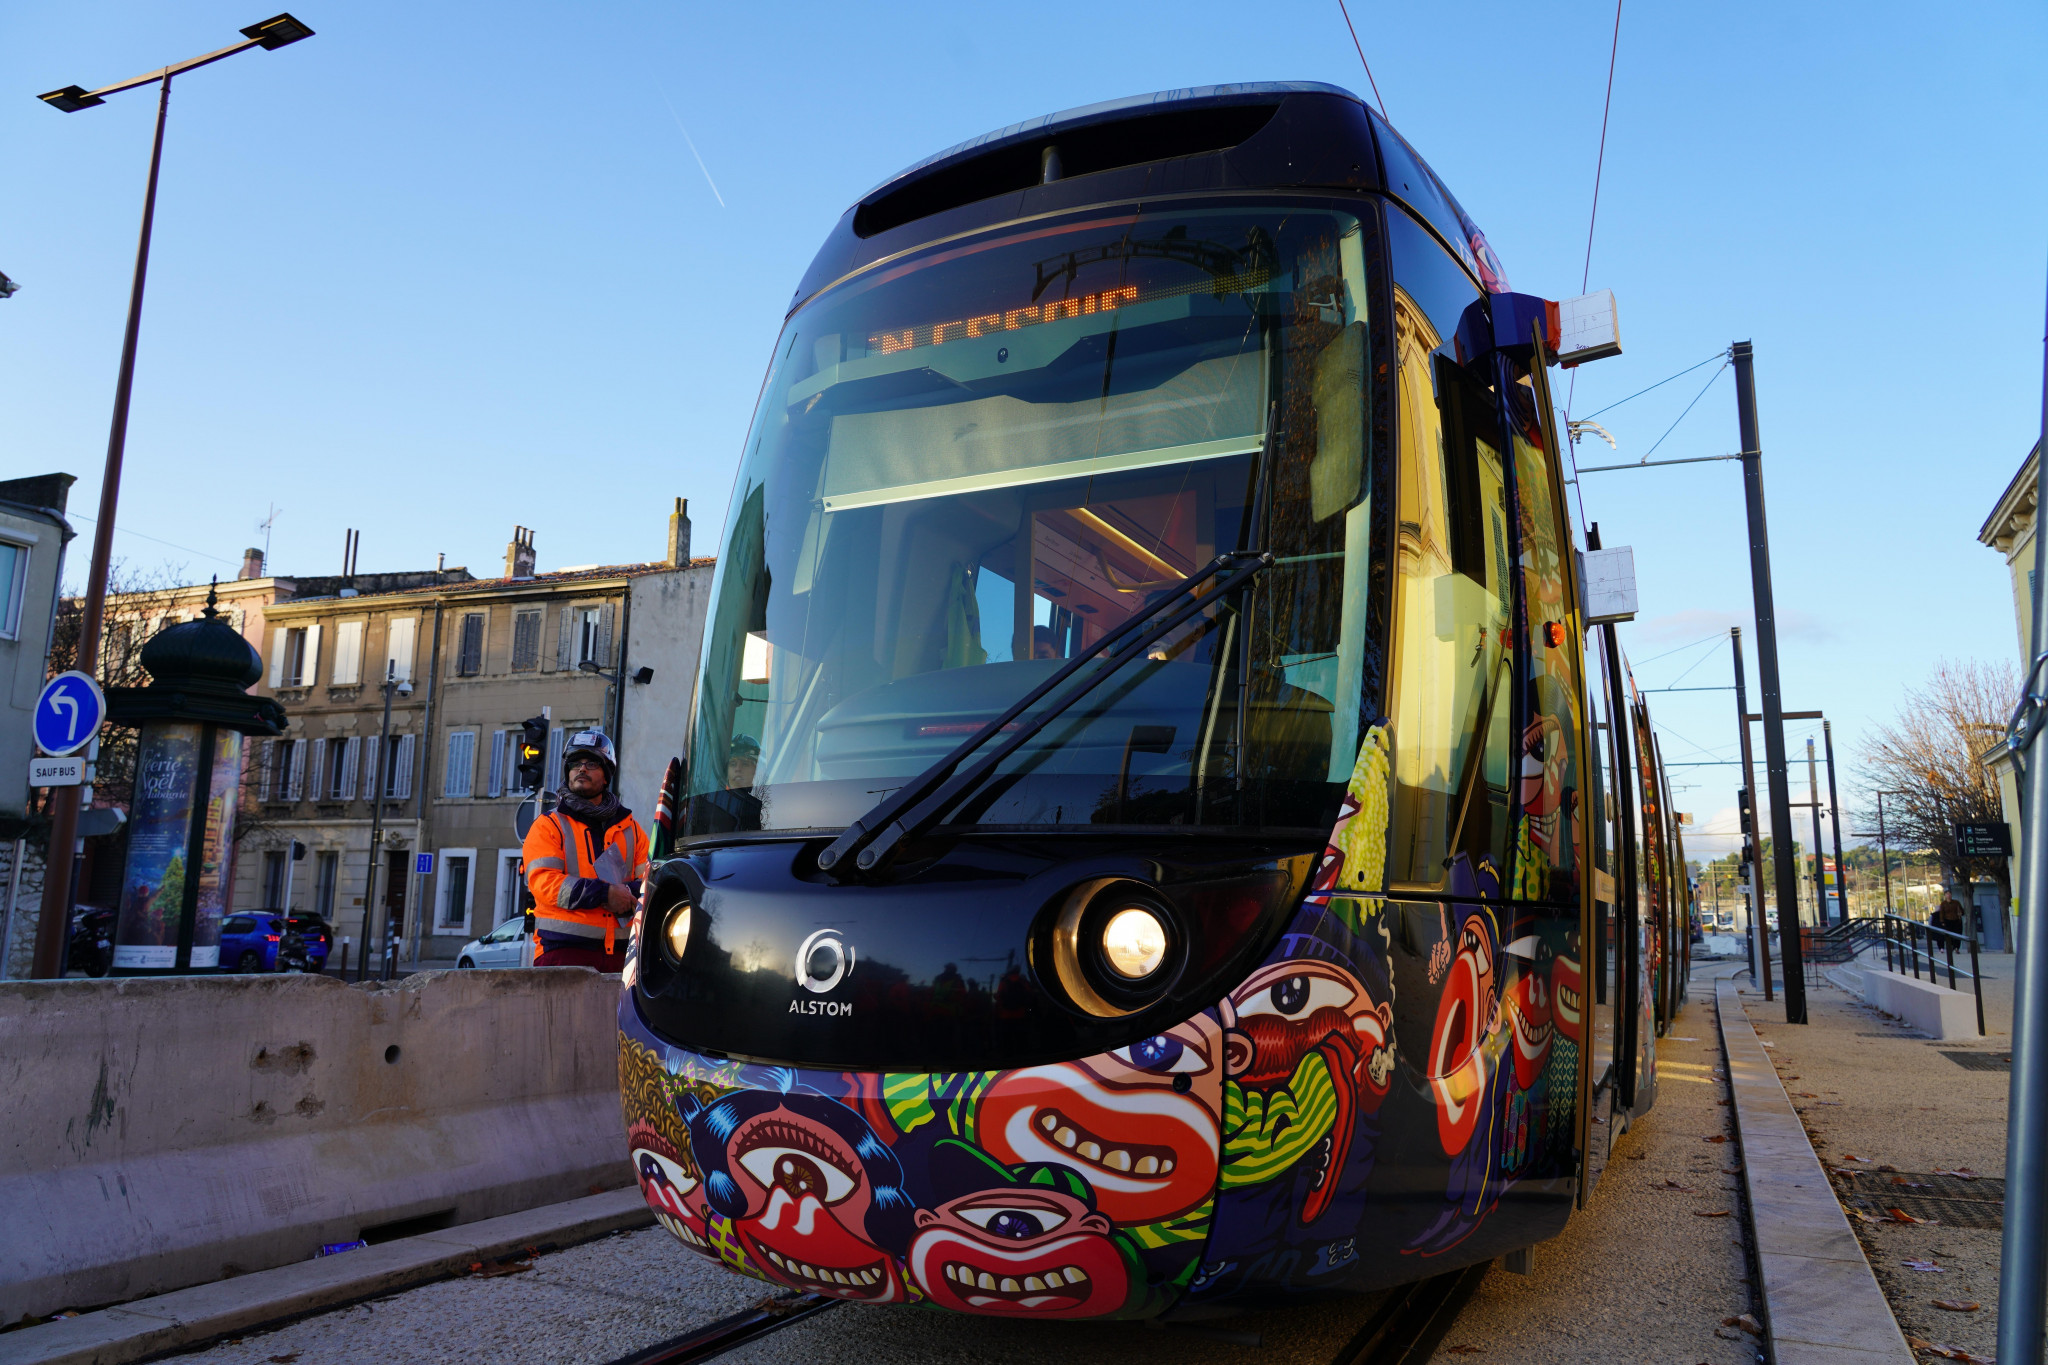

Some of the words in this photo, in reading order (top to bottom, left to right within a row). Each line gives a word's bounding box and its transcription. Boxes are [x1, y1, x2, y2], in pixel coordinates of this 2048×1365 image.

[36, 767, 58, 778] SAUF
[59, 766, 76, 777] BUS
[788, 1000, 853, 1016] ALSTOM
